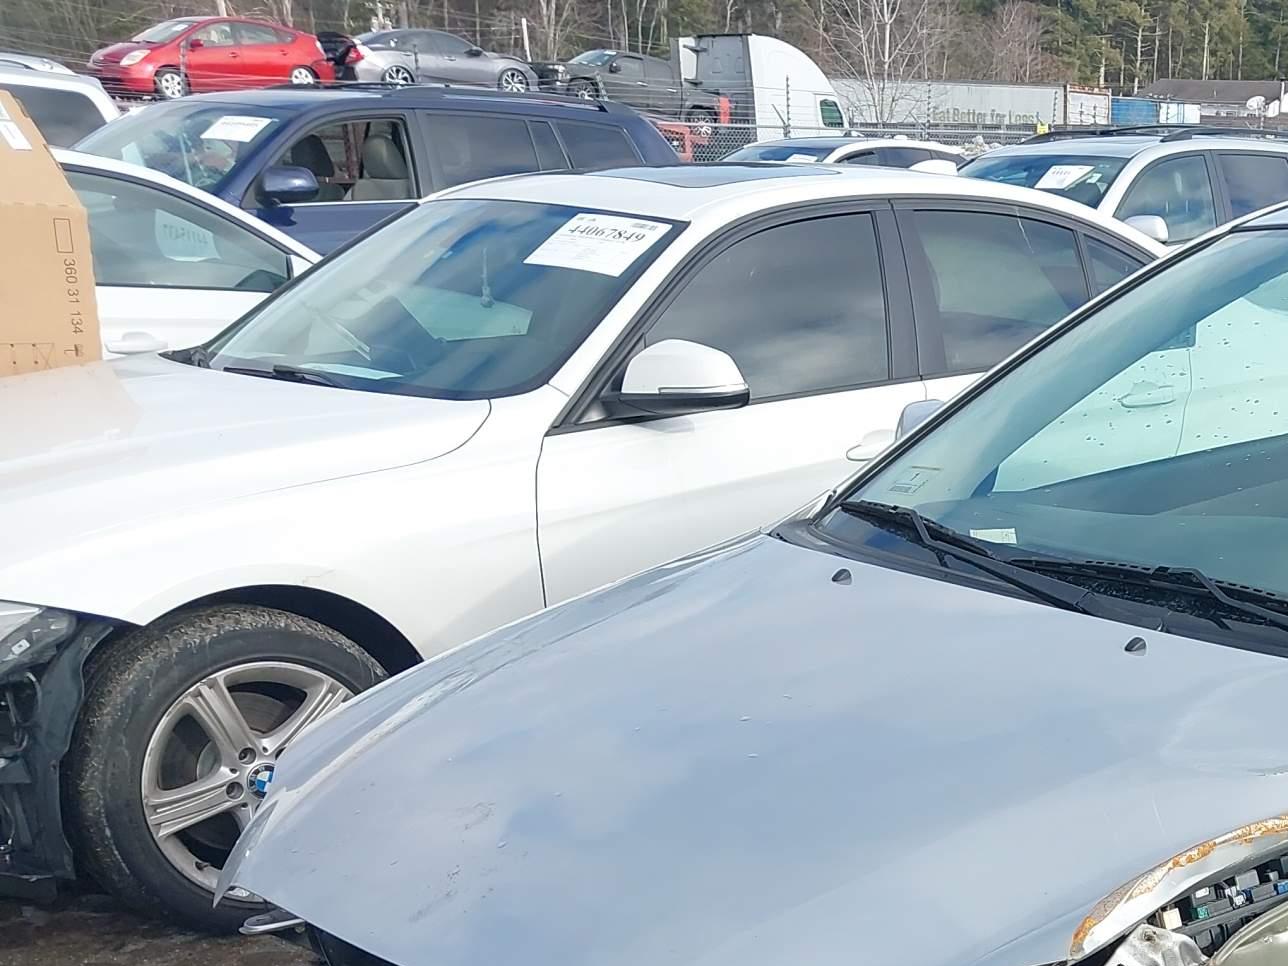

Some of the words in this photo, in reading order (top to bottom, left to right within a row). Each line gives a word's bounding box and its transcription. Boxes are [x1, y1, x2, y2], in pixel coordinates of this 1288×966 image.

[568, 225, 646, 243] 44067849
[63, 258, 78, 284] 360
[67, 288, 81, 303] 31
[70, 310, 84, 335] 134
